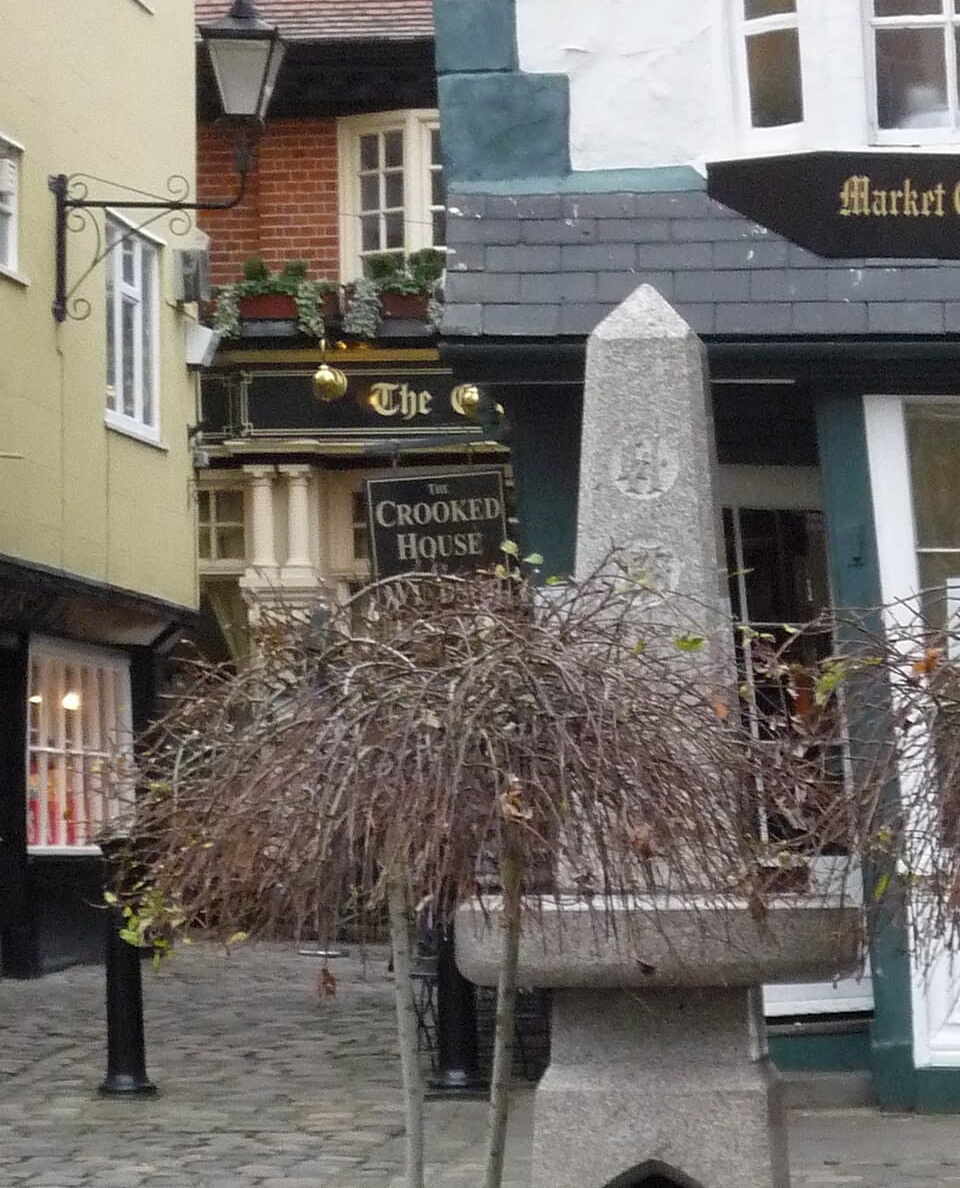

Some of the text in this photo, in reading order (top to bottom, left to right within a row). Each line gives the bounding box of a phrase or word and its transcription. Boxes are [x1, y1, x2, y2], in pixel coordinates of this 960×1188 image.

[839, 174, 945, 217] Market
[369, 381, 432, 421] The
[376, 498, 501, 527] CROOKED
[396, 532, 483, 560] HOUSE
